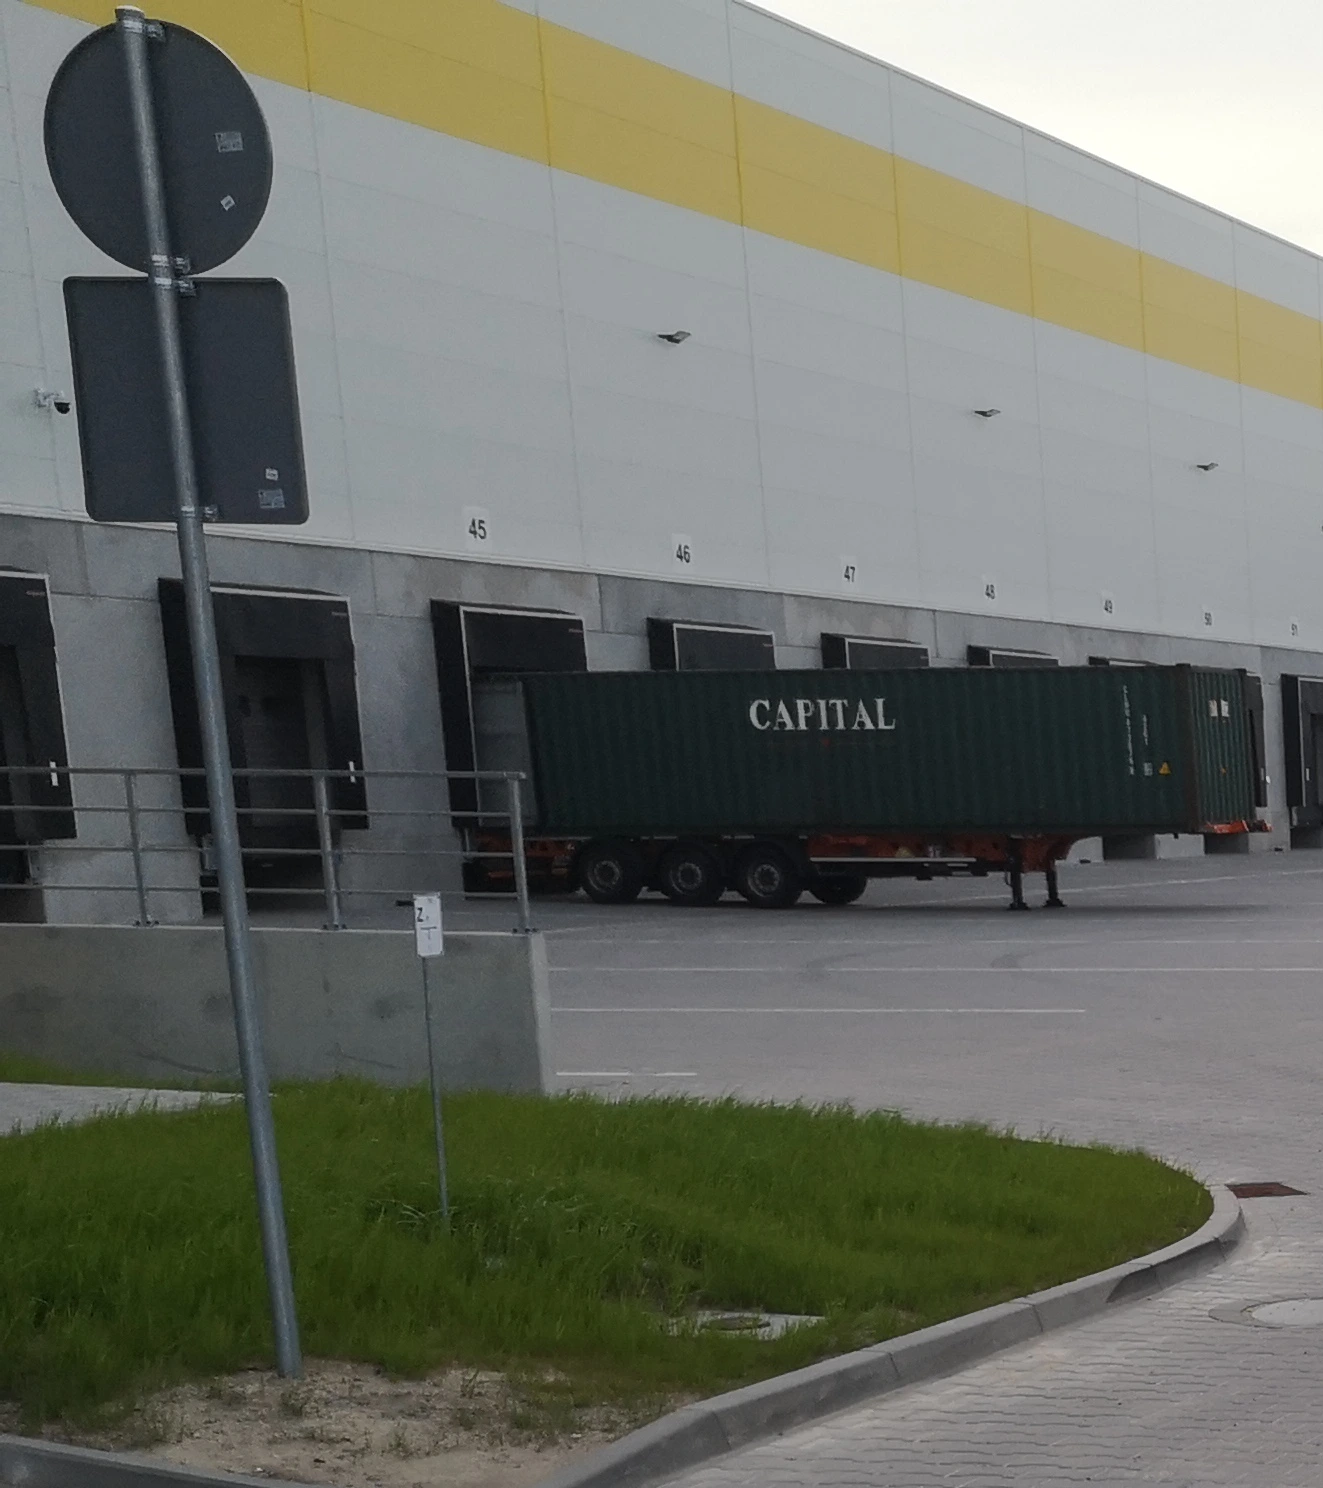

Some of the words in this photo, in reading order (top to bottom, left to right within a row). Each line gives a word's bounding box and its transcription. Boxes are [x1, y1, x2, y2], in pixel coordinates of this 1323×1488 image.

[468, 518, 487, 540] 45
[676, 544, 691, 563] 46
[844, 565, 856, 582] 47
[985, 584, 995, 600] 48
[749, 698, 896, 731] CAPITAL
